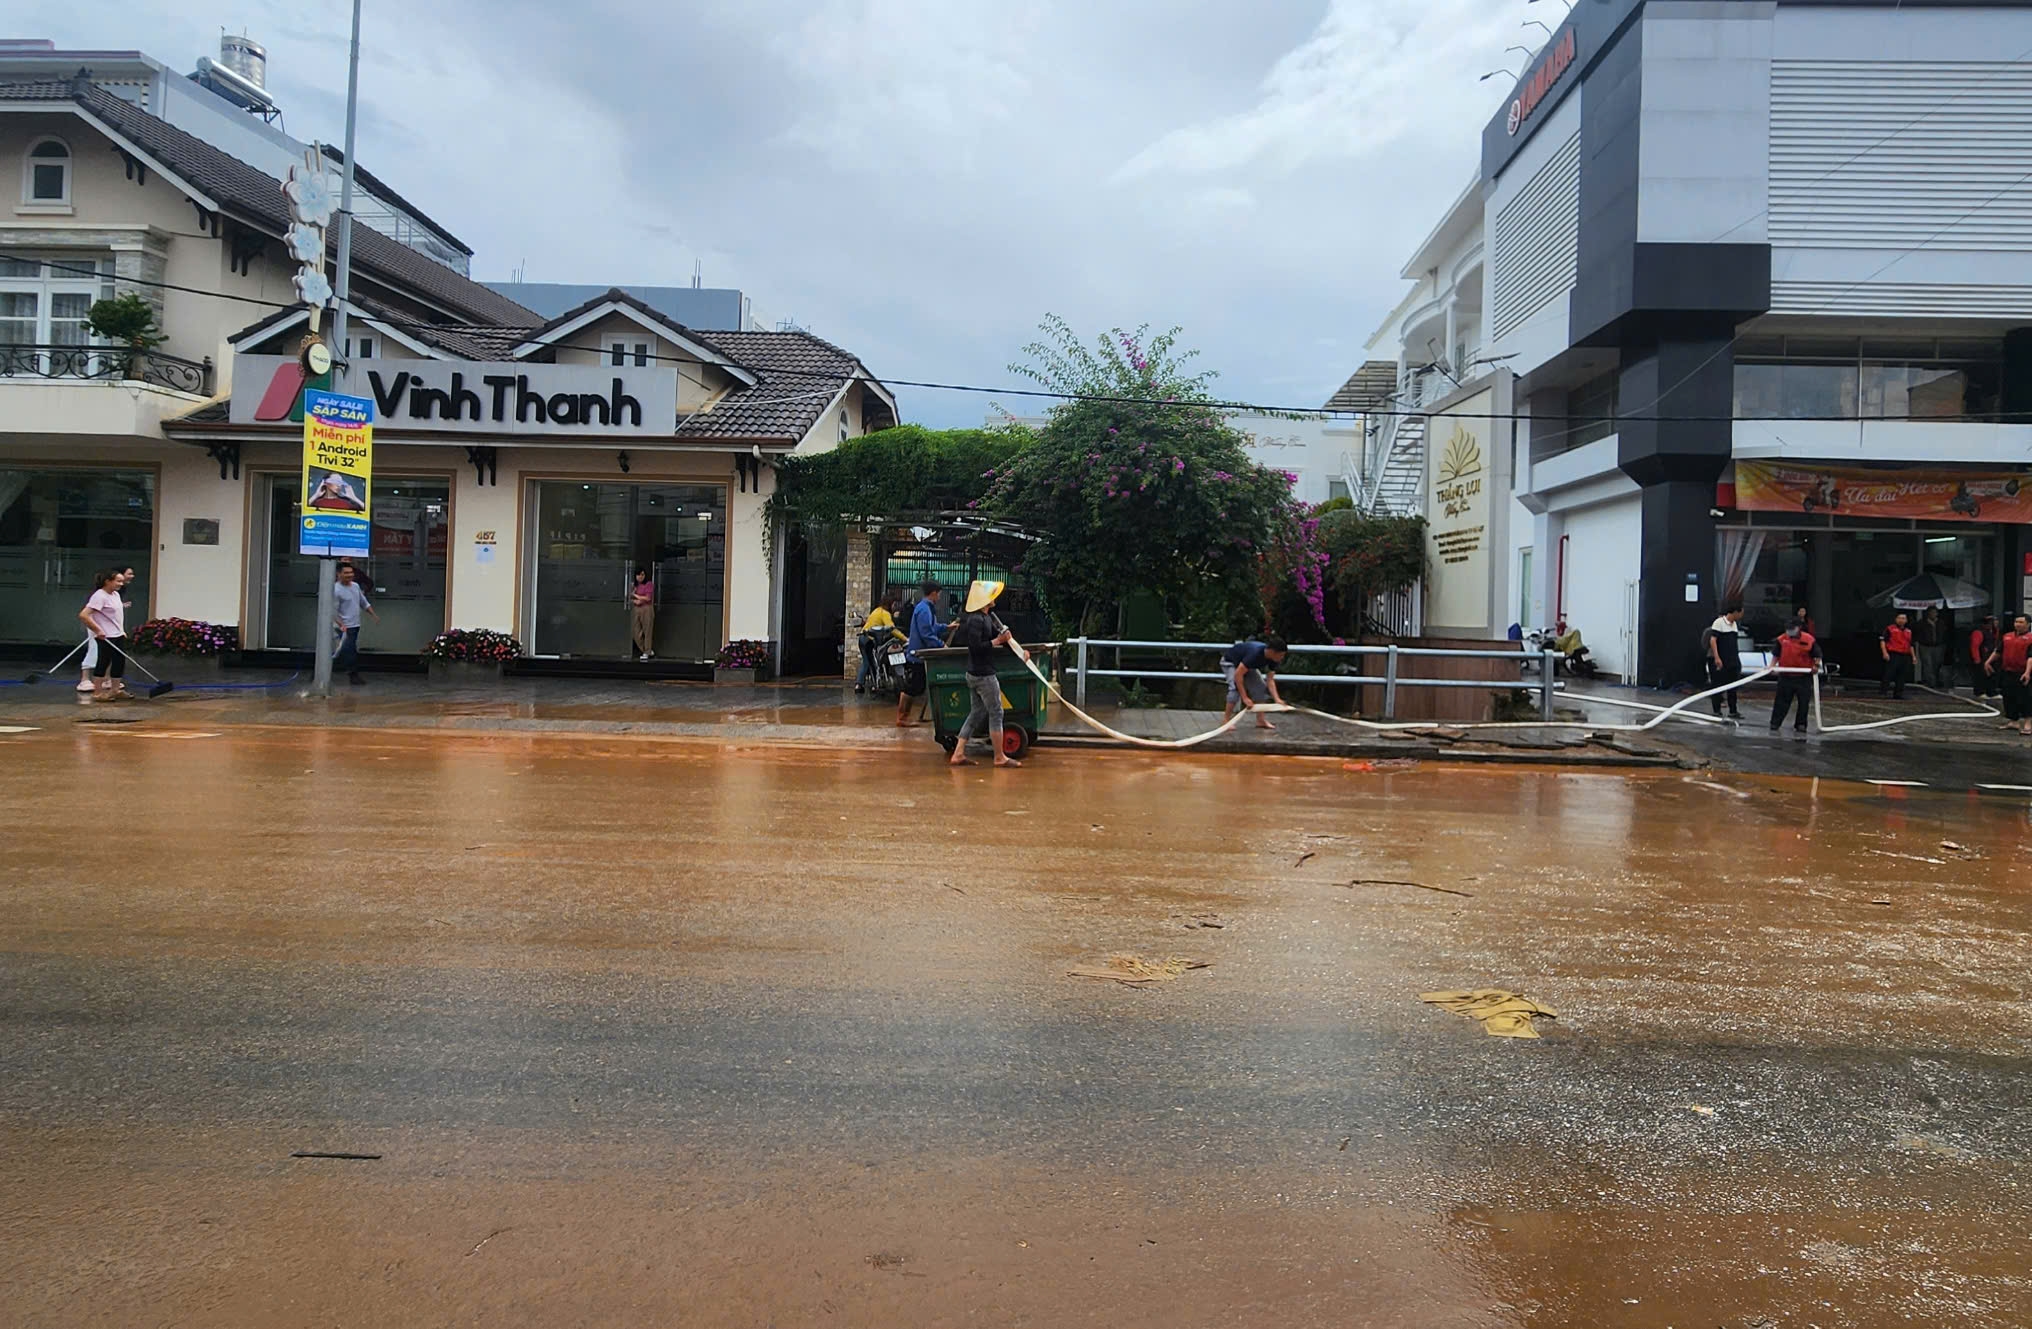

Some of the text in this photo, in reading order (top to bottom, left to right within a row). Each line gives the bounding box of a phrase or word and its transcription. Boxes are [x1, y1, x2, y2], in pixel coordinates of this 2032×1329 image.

[1519, 26, 1577, 121] YAMAHA
[313, 427, 366, 445] Miễn phí
[310, 440, 367, 458] 1 Android
[317, 453, 338, 466] Tivi
